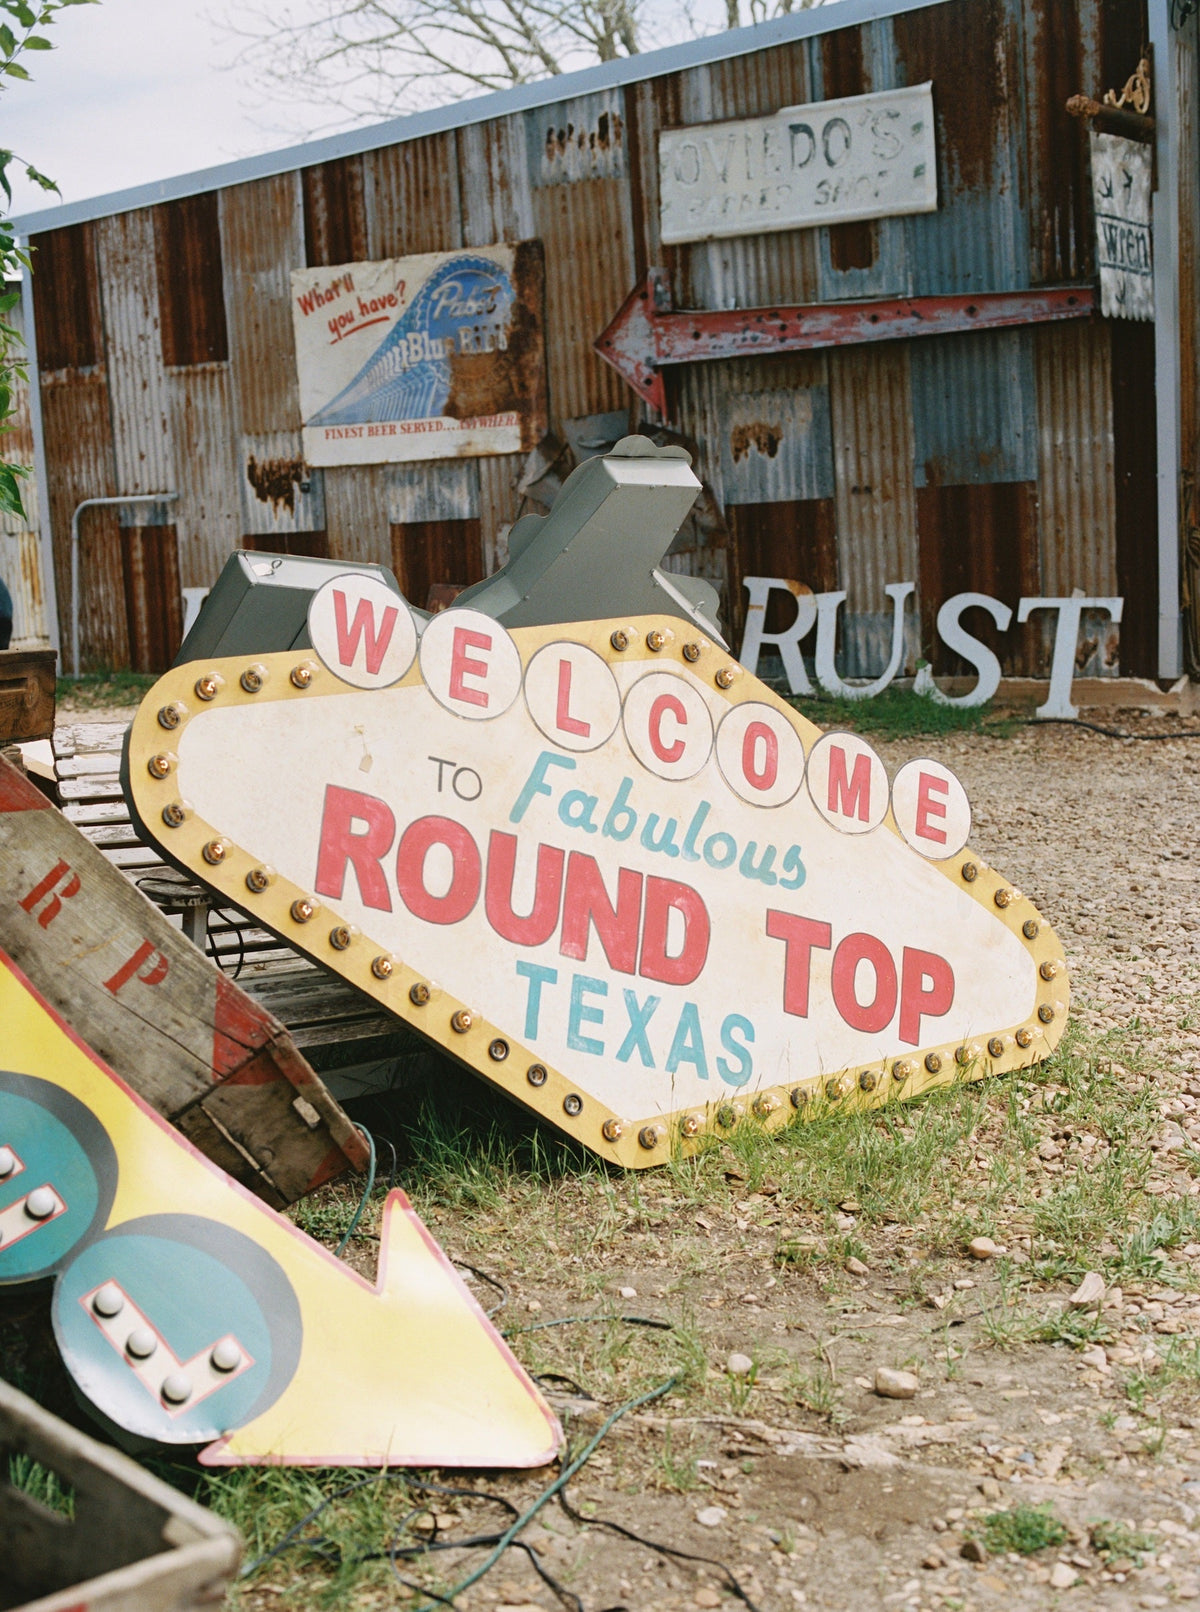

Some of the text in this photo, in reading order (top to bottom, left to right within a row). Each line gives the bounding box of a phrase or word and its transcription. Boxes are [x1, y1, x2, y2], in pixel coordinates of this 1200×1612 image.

[1101, 222, 1149, 269] Wren
[296, 272, 355, 317] What'll
[328, 280, 406, 341] you have?
[430, 281, 502, 320] Pabst
[324, 426, 364, 440] FINEST
[367, 423, 397, 437] BEER
[738, 575, 1124, 719] RUST
[332, 589, 949, 845] WELCOME
[428, 755, 482, 801] TO
[509, 750, 807, 890] Fabulous
[314, 783, 955, 1047] ROUND TOP
[515, 960, 755, 1087] TEXAS
